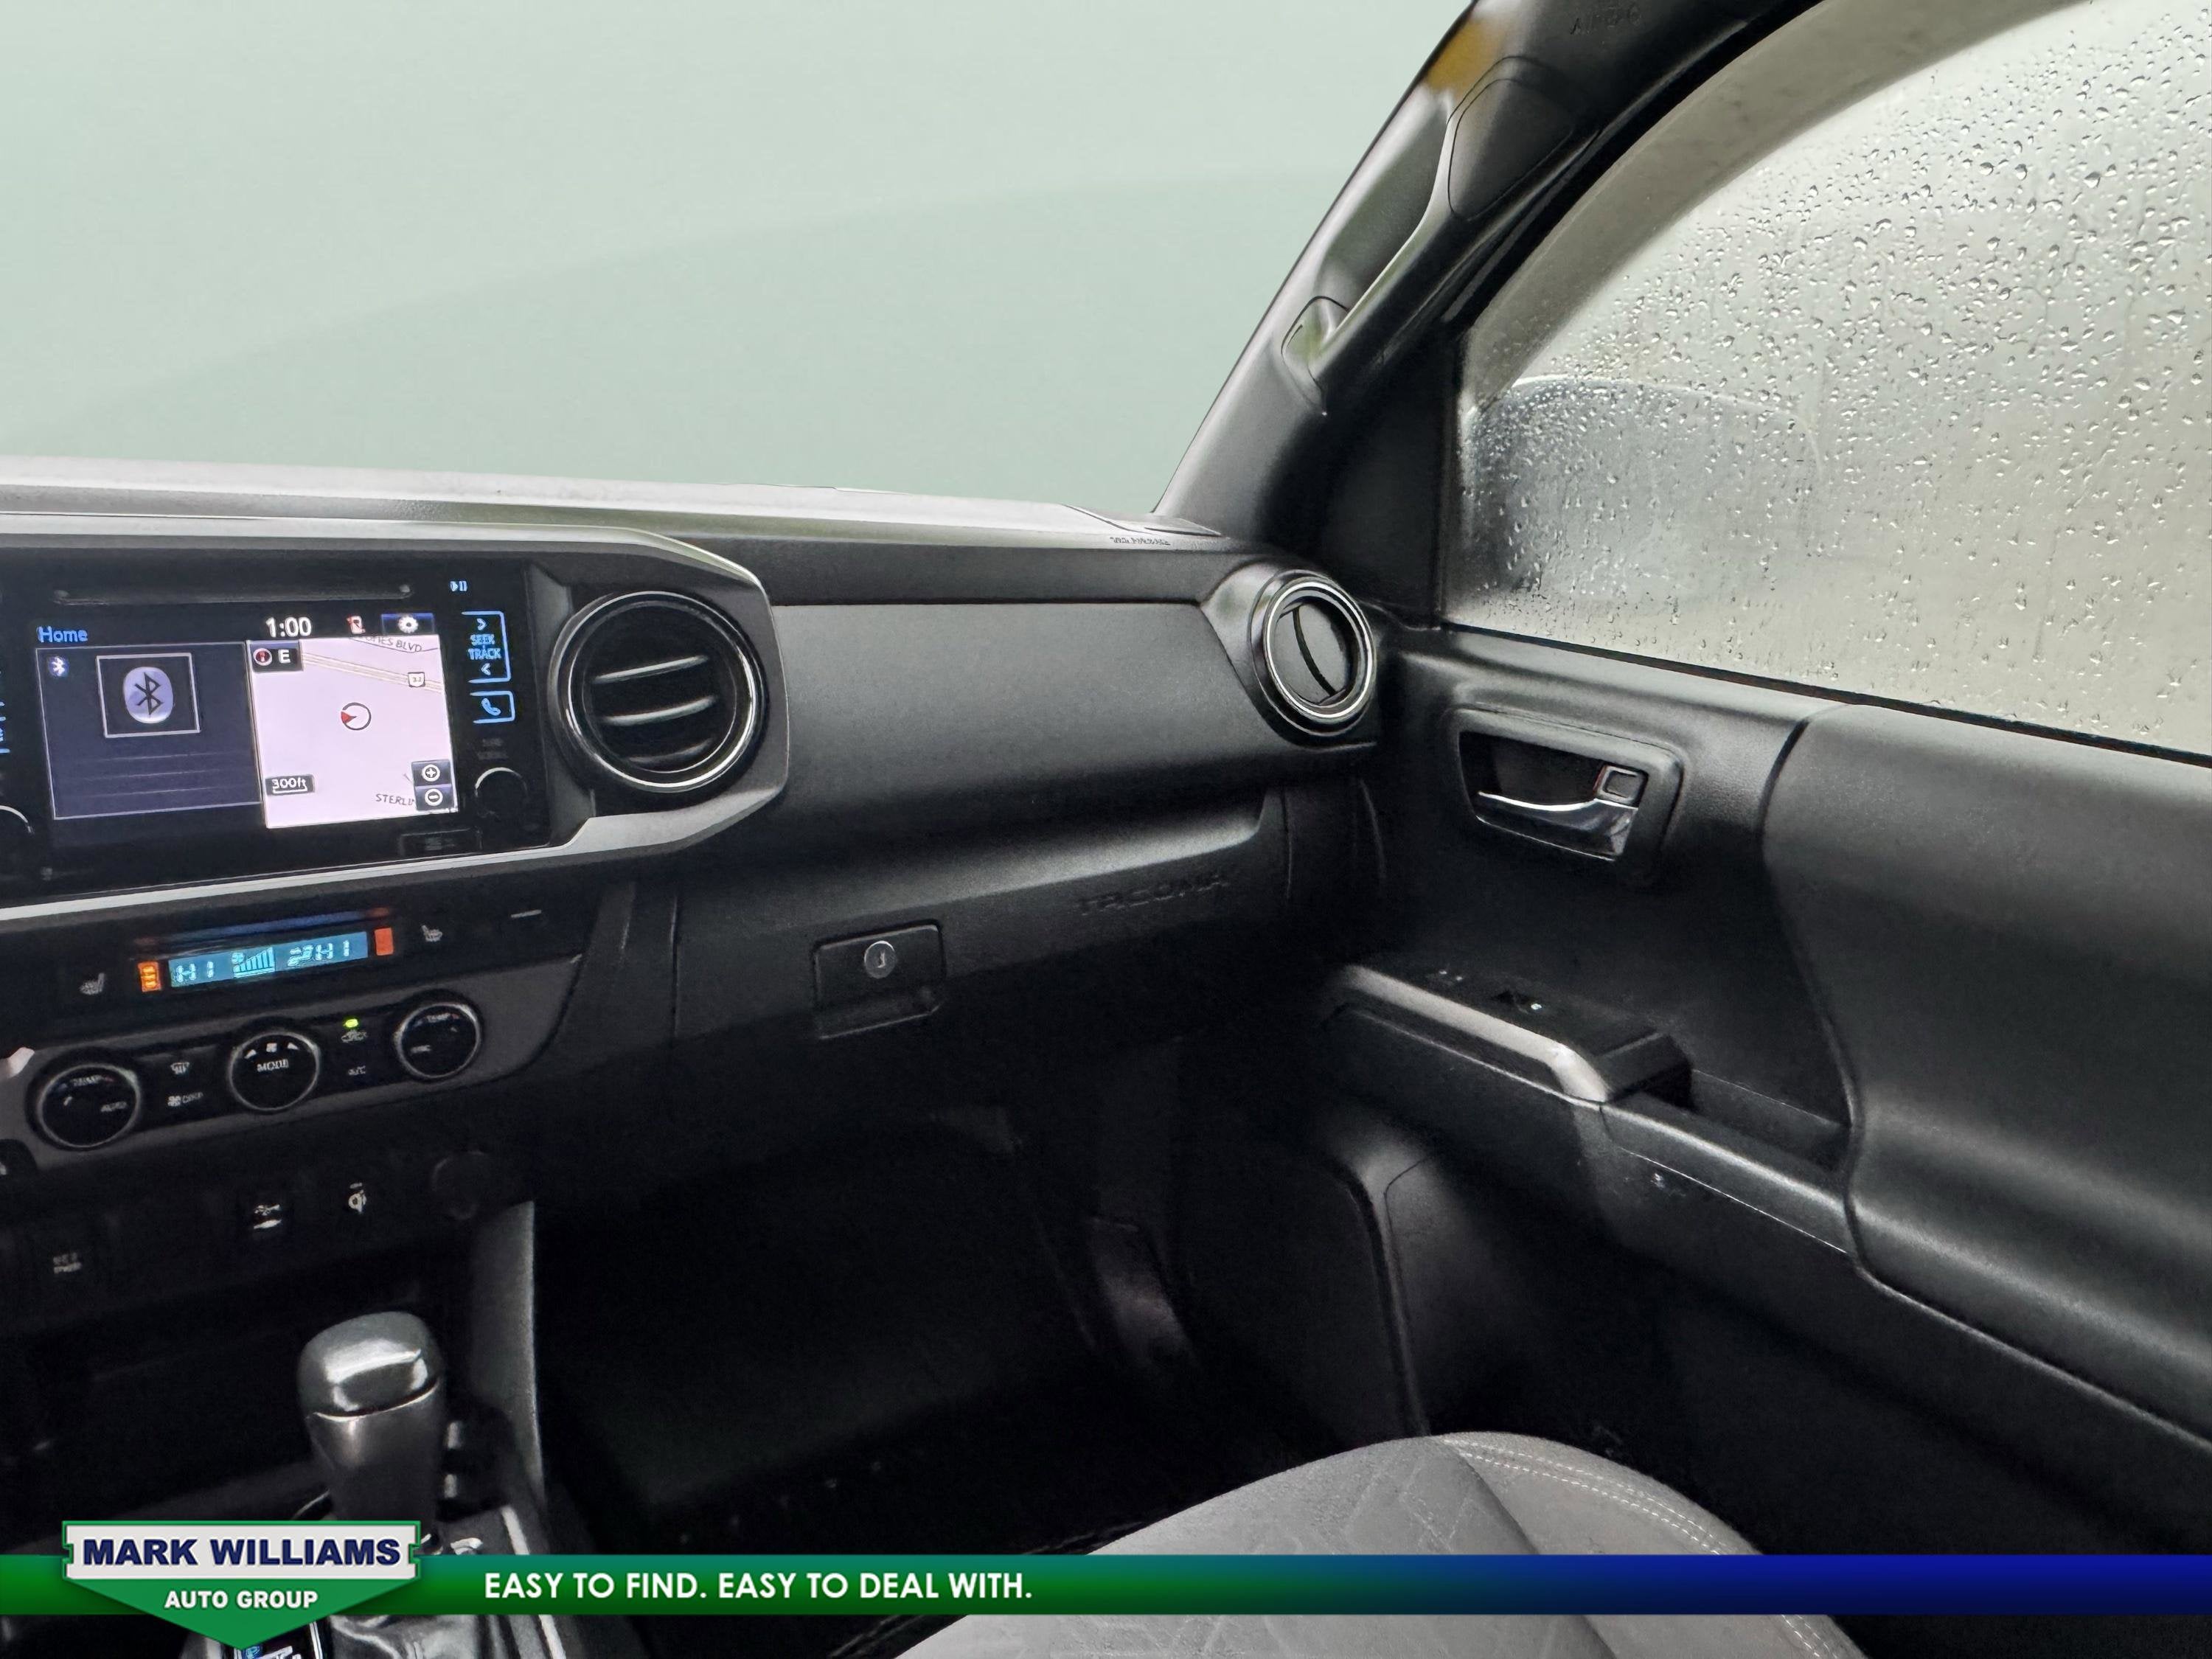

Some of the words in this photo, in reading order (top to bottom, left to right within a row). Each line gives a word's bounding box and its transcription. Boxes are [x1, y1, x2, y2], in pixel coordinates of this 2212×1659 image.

[37, 625, 88, 643] Home
[265, 616, 313, 638] 1:00
[395, 639, 423, 653] BLVD
[470, 633, 495, 646] SEEK
[278, 649, 290, 662] E
[467, 647, 502, 661] TRACK
[257, 1059, 290, 1073] MODE
